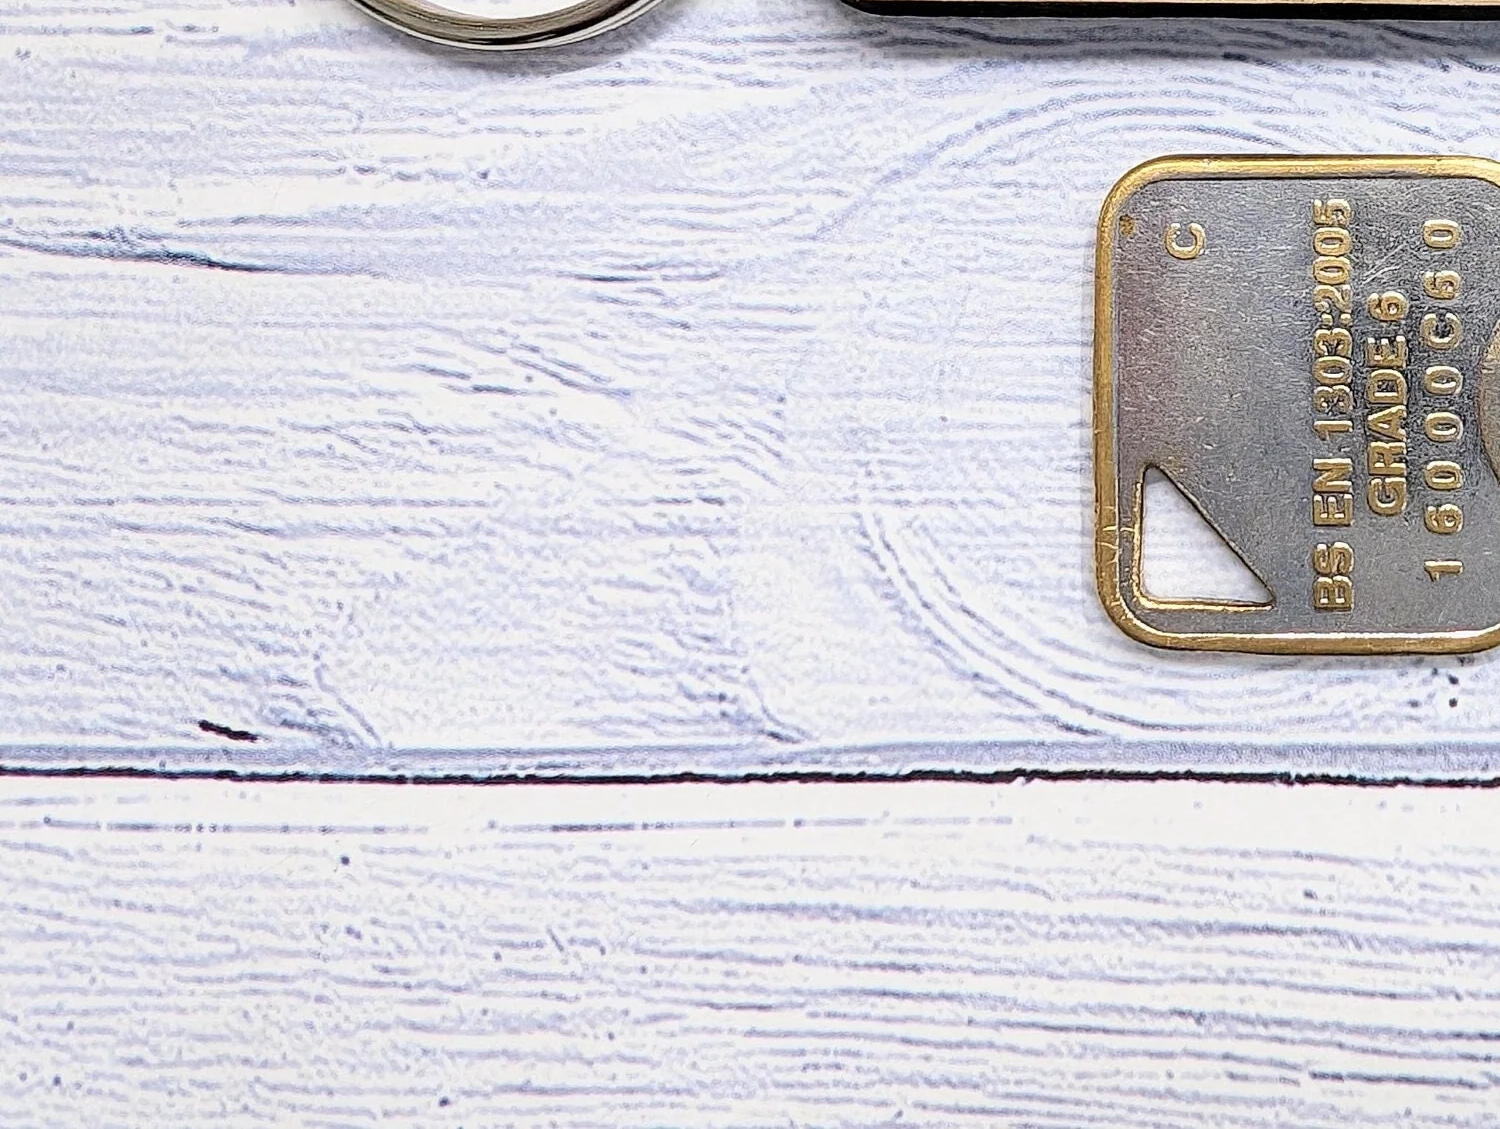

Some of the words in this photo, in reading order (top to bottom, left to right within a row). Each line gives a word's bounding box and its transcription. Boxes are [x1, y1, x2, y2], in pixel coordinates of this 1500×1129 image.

[1165, 222, 1206, 260] C
[1313, 198, 1355, 442] 1303:2005
[1367, 290, 1409, 323] 6
[1367, 334, 1409, 517] GRADE
[1313, 457, 1355, 528] EN
[1313, 541, 1355, 611] BS
